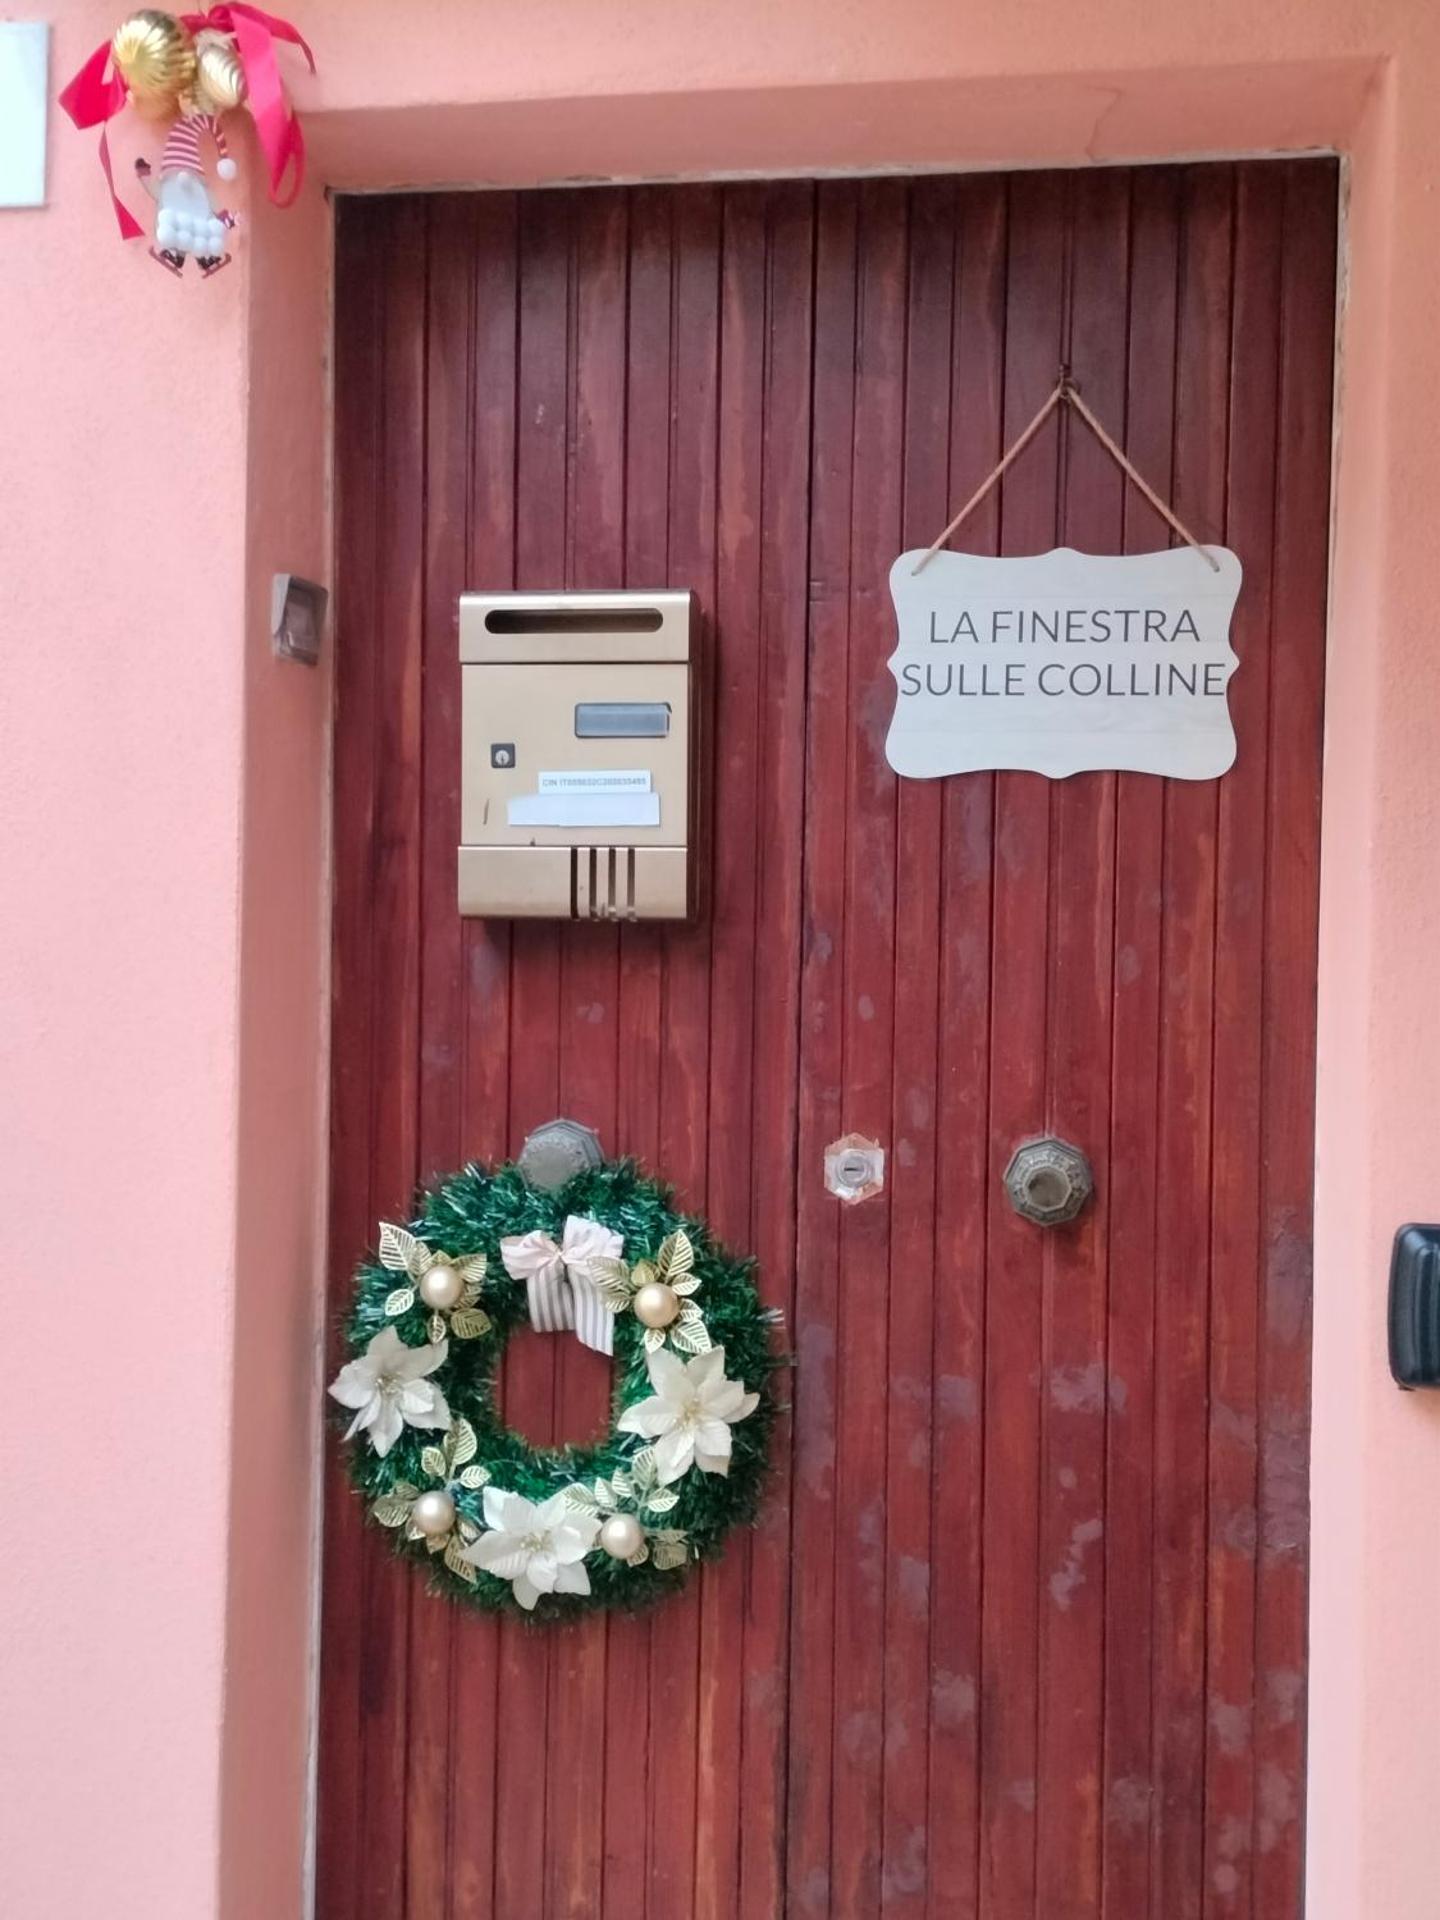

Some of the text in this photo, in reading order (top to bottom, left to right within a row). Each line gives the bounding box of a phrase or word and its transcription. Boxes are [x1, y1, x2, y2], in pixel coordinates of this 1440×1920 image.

[930, 609, 1201, 643] LA FINESTRA
[901, 663, 1226, 696] SULLE COLLINE
